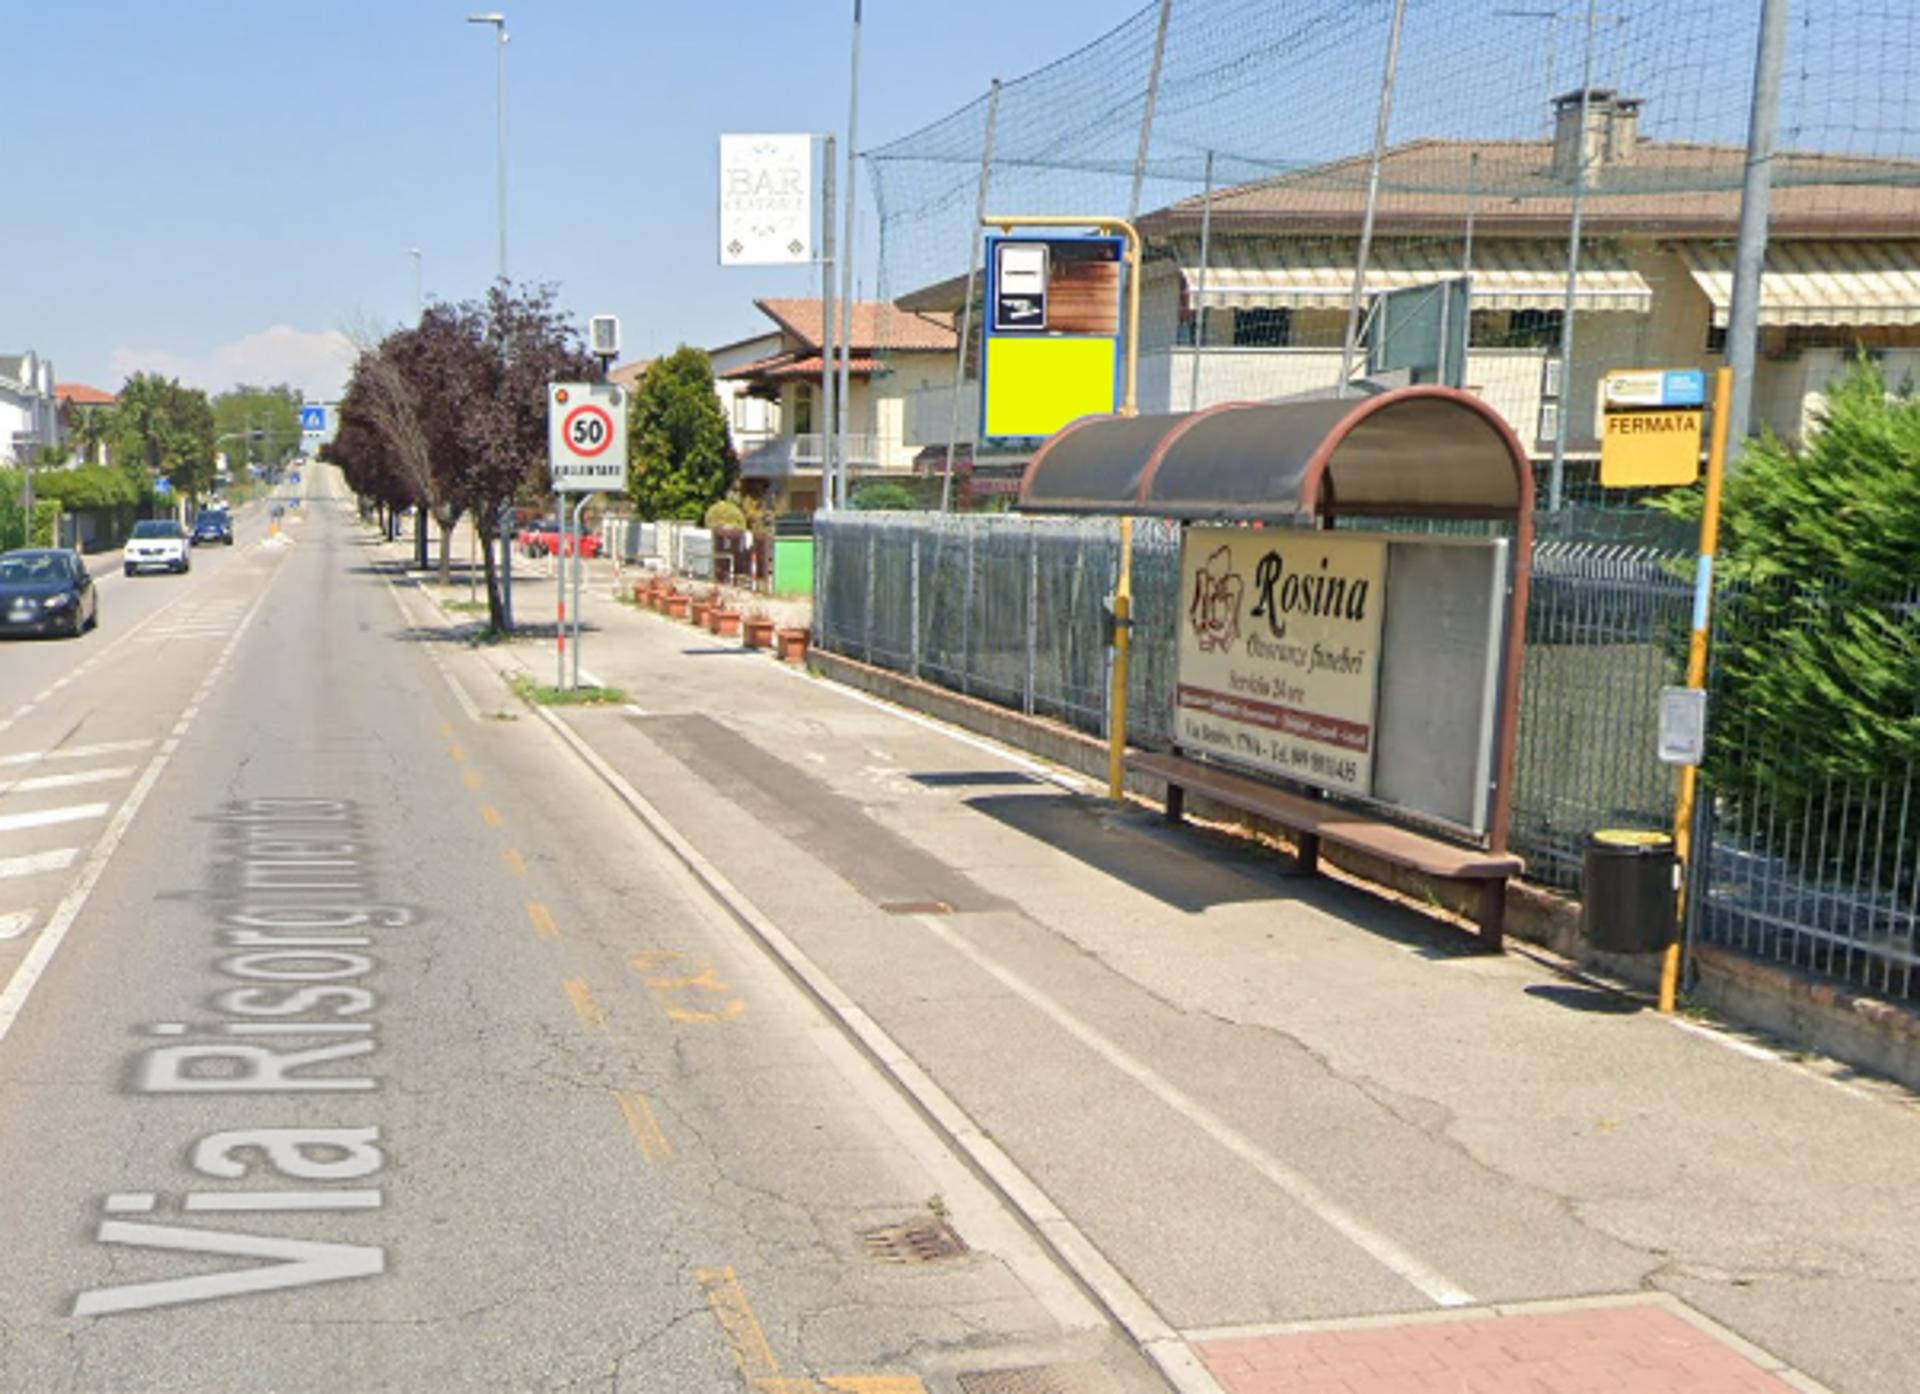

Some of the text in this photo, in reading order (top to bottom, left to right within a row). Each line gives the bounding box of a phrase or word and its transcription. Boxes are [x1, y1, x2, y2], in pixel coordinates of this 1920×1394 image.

[726, 167, 805, 195] BAR
[573, 419, 603, 444] 50
[1607, 414, 1697, 435] FERMATA
[1251, 549, 1369, 638] Rosina
